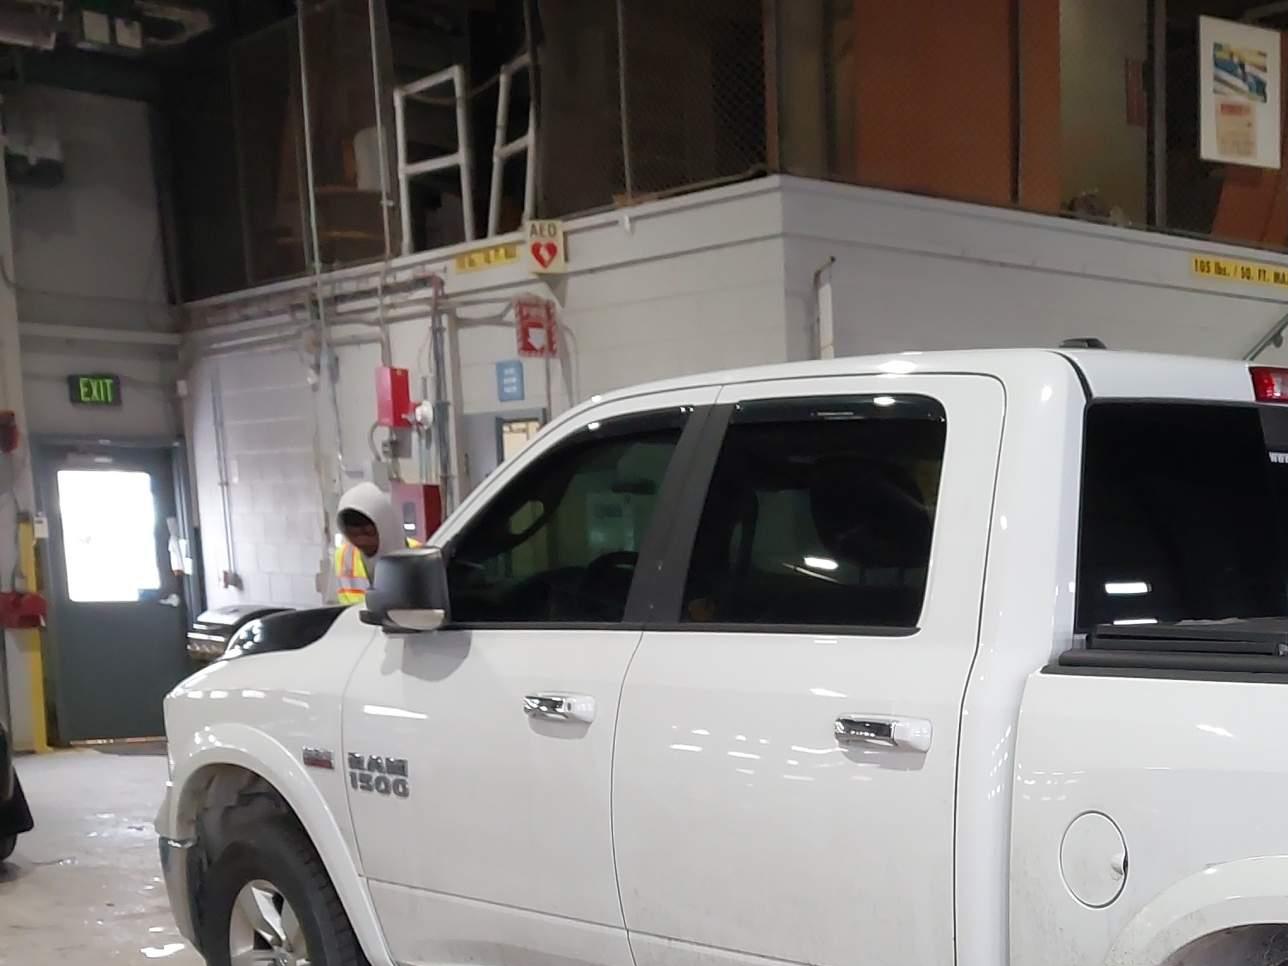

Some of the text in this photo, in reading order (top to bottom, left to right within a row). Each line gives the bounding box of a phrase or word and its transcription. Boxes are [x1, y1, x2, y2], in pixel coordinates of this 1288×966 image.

[529, 223, 557, 238] AED
[1194, 258, 1211, 274] 105
[79, 377, 113, 402] EXIT
[349, 771, 410, 798] 1500
